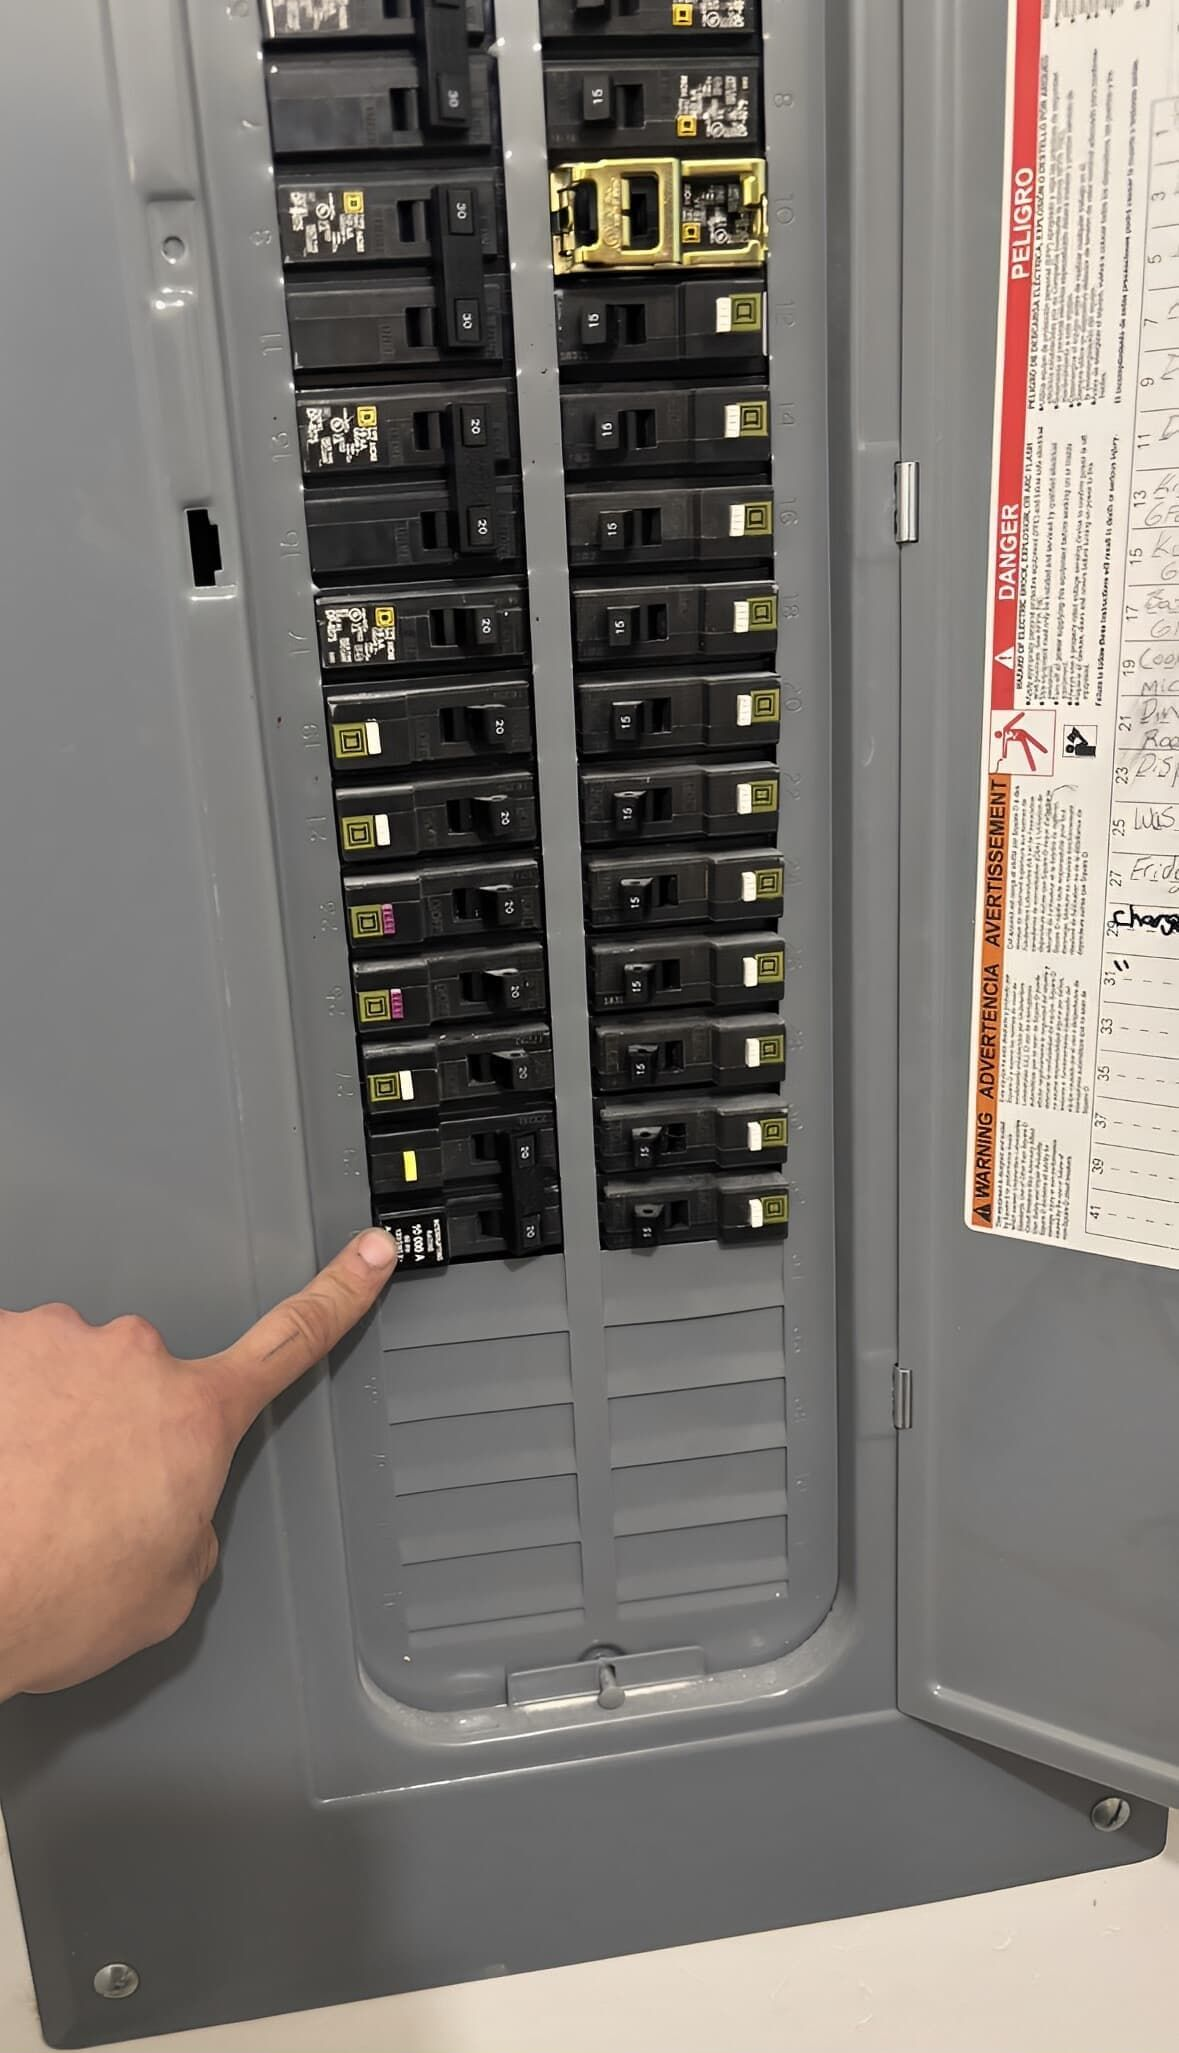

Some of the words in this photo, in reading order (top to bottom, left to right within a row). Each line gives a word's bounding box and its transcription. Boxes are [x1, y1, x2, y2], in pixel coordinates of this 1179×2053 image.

[448, 90, 459, 108] 30
[591, 88, 603, 104] 15
[1151, 190, 1166, 201] 3
[456, 202, 467, 219] 30
[1010, 166, 1035, 281] PELIGRO
[1147, 253, 1162, 265] 5
[462, 313, 473, 329] 30
[588, 313, 599, 328] 15
[1144, 318, 1159, 327] 7
[1140, 376, 1155, 387] 9
[471, 418, 481, 434] 20
[1137, 434, 1151, 448] 11
[1133, 490, 1147, 507] 13
[478, 519, 488, 535] 20
[607, 522, 617, 536] 15
[998, 504, 1019, 601] DANGER
[1129, 548, 1143, 565] 15
[1126, 605, 1139, 620] 17
[481, 618, 491, 634] 20
[614, 620, 625, 634] 15
[1122, 659, 1136, 676] 19
[495, 719, 505, 735] 20
[620, 716, 631, 729] 15
[1118, 715, 1132, 732] 21
[1115, 766, 1129, 784] 23
[501, 811, 510, 825] 20
[622, 807, 633, 820] 15
[1112, 819, 1126, 837] 25
[984, 780, 1007, 948] AVERTISSEMENT
[1109, 870, 1122, 887] 27
[504, 901, 514, 914] 20
[630, 897, 640, 908] 15
[1106, 920, 1119, 937] 29
[1103, 970, 1115, 986] 31
[511, 985, 520, 999] 20
[978, 963, 999, 1100] ADVERTENCIA
[1101, 1018, 1113, 1034] 33
[518, 1066, 528, 1079] 20
[636, 1063, 645, 1075] 15
[1097, 1065, 1110, 1081] 35
[1094, 1111, 1107, 1128] 37
[520, 1146, 529, 1159] 20
[975, 1112, 993, 1199] WARNING
[1091, 1158, 1104, 1175] 39
[1089, 1205, 1101, 1219] 41
[526, 1225, 535, 1238] 20
